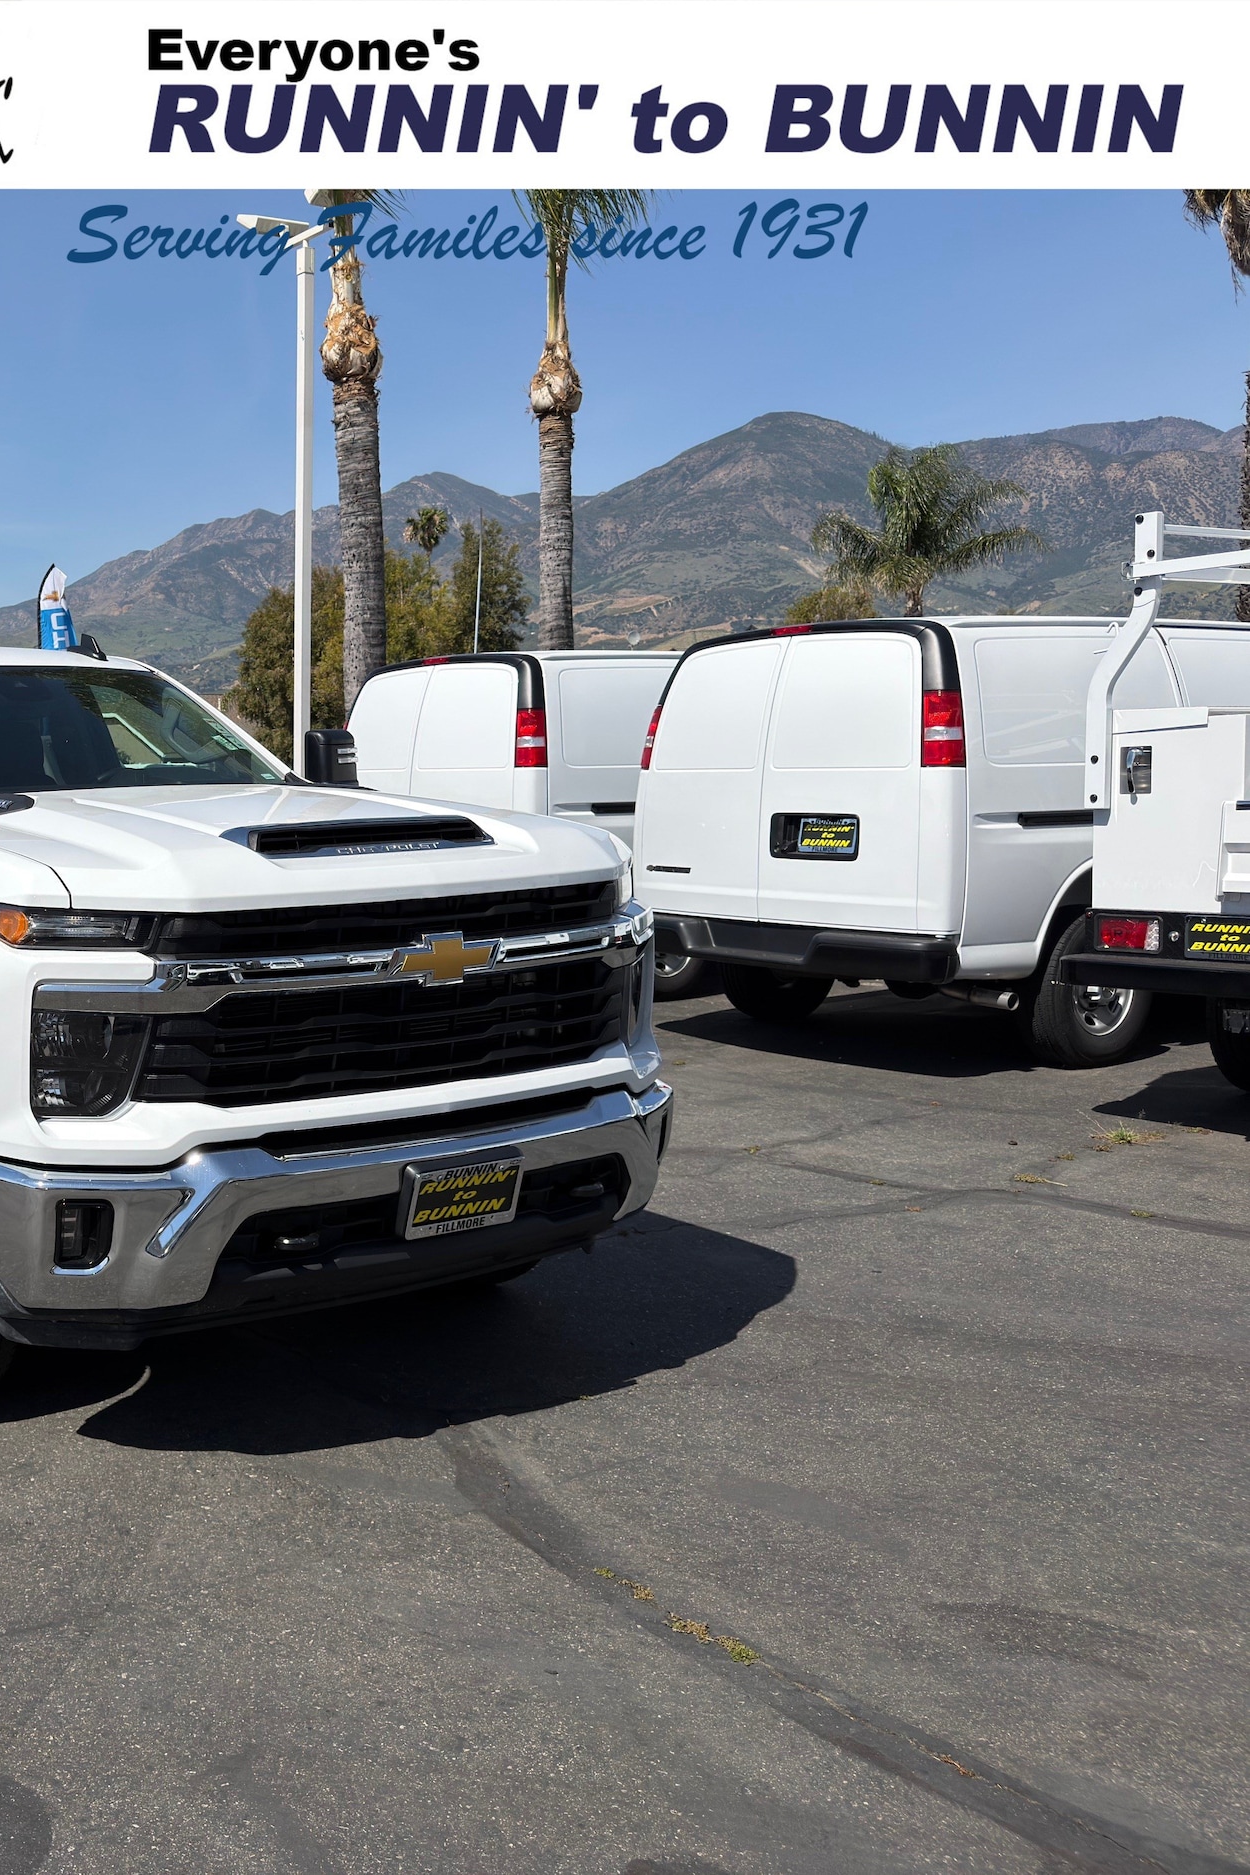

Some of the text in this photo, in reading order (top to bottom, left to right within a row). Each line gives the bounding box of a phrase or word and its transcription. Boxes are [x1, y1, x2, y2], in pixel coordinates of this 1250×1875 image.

[801, 838, 851, 847] BUNNIN
[1190, 923, 1250, 934] RUNNI
[1219, 933, 1241, 942] to
[1190, 941, 1250, 953] BUNNI
[444, 1162, 499, 1180] BUNNIN
[418, 1169, 517, 1196] RUNNIN'
[452, 1190, 478, 1201] to
[412, 1197, 506, 1224] BUNNIN
[435, 1216, 486, 1234] FILLMORE
